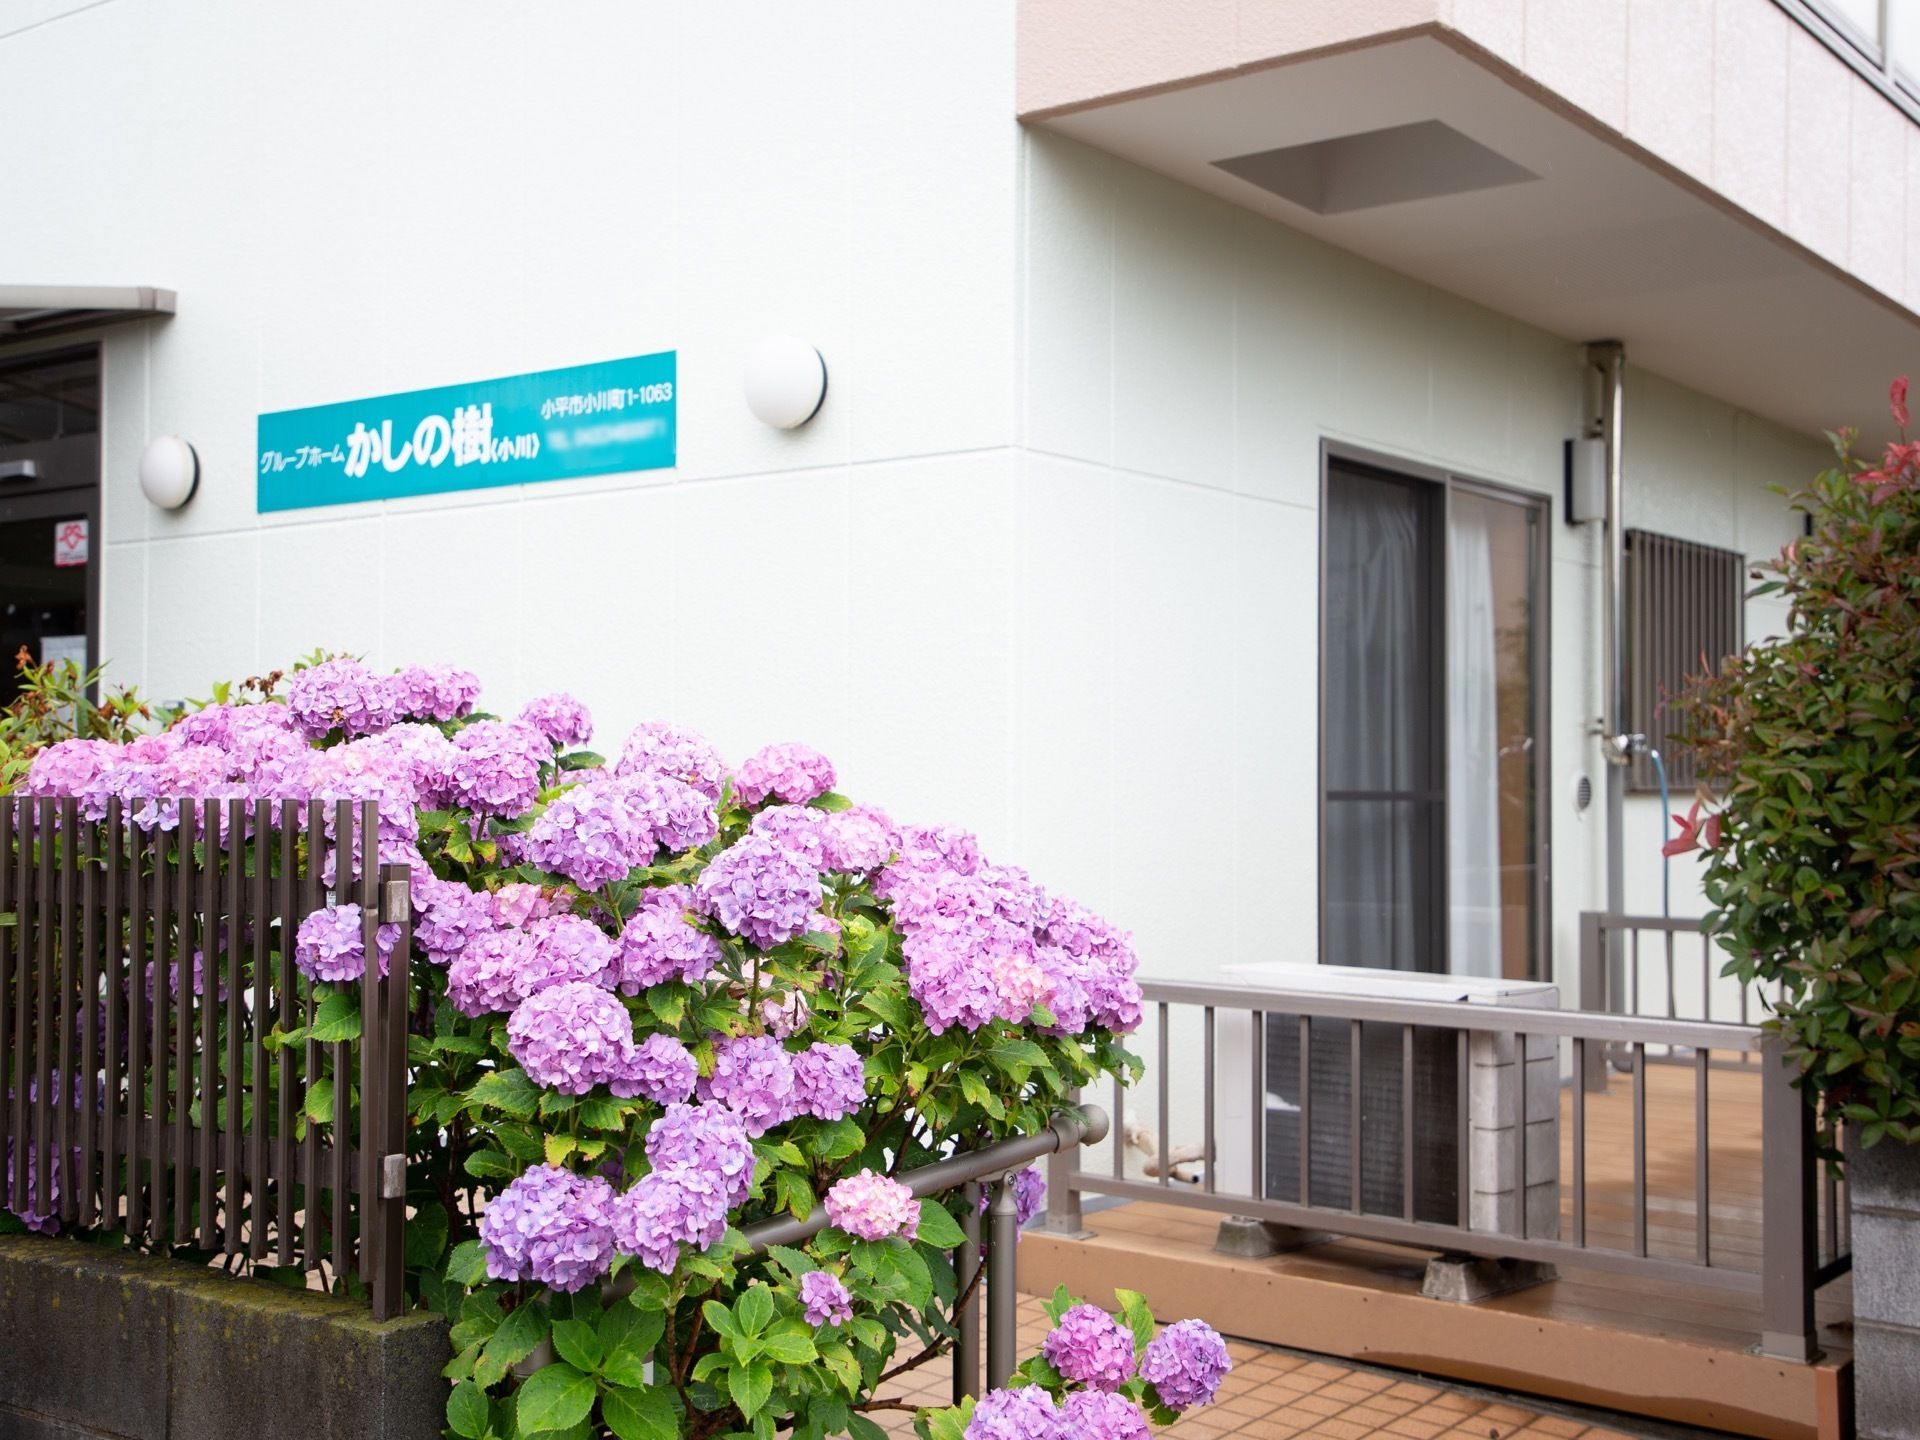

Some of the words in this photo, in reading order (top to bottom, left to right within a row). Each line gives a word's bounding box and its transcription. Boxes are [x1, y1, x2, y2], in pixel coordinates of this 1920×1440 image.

[260, 444, 345, 474] グループホーム
[344, 402, 493, 478] かしの樹
